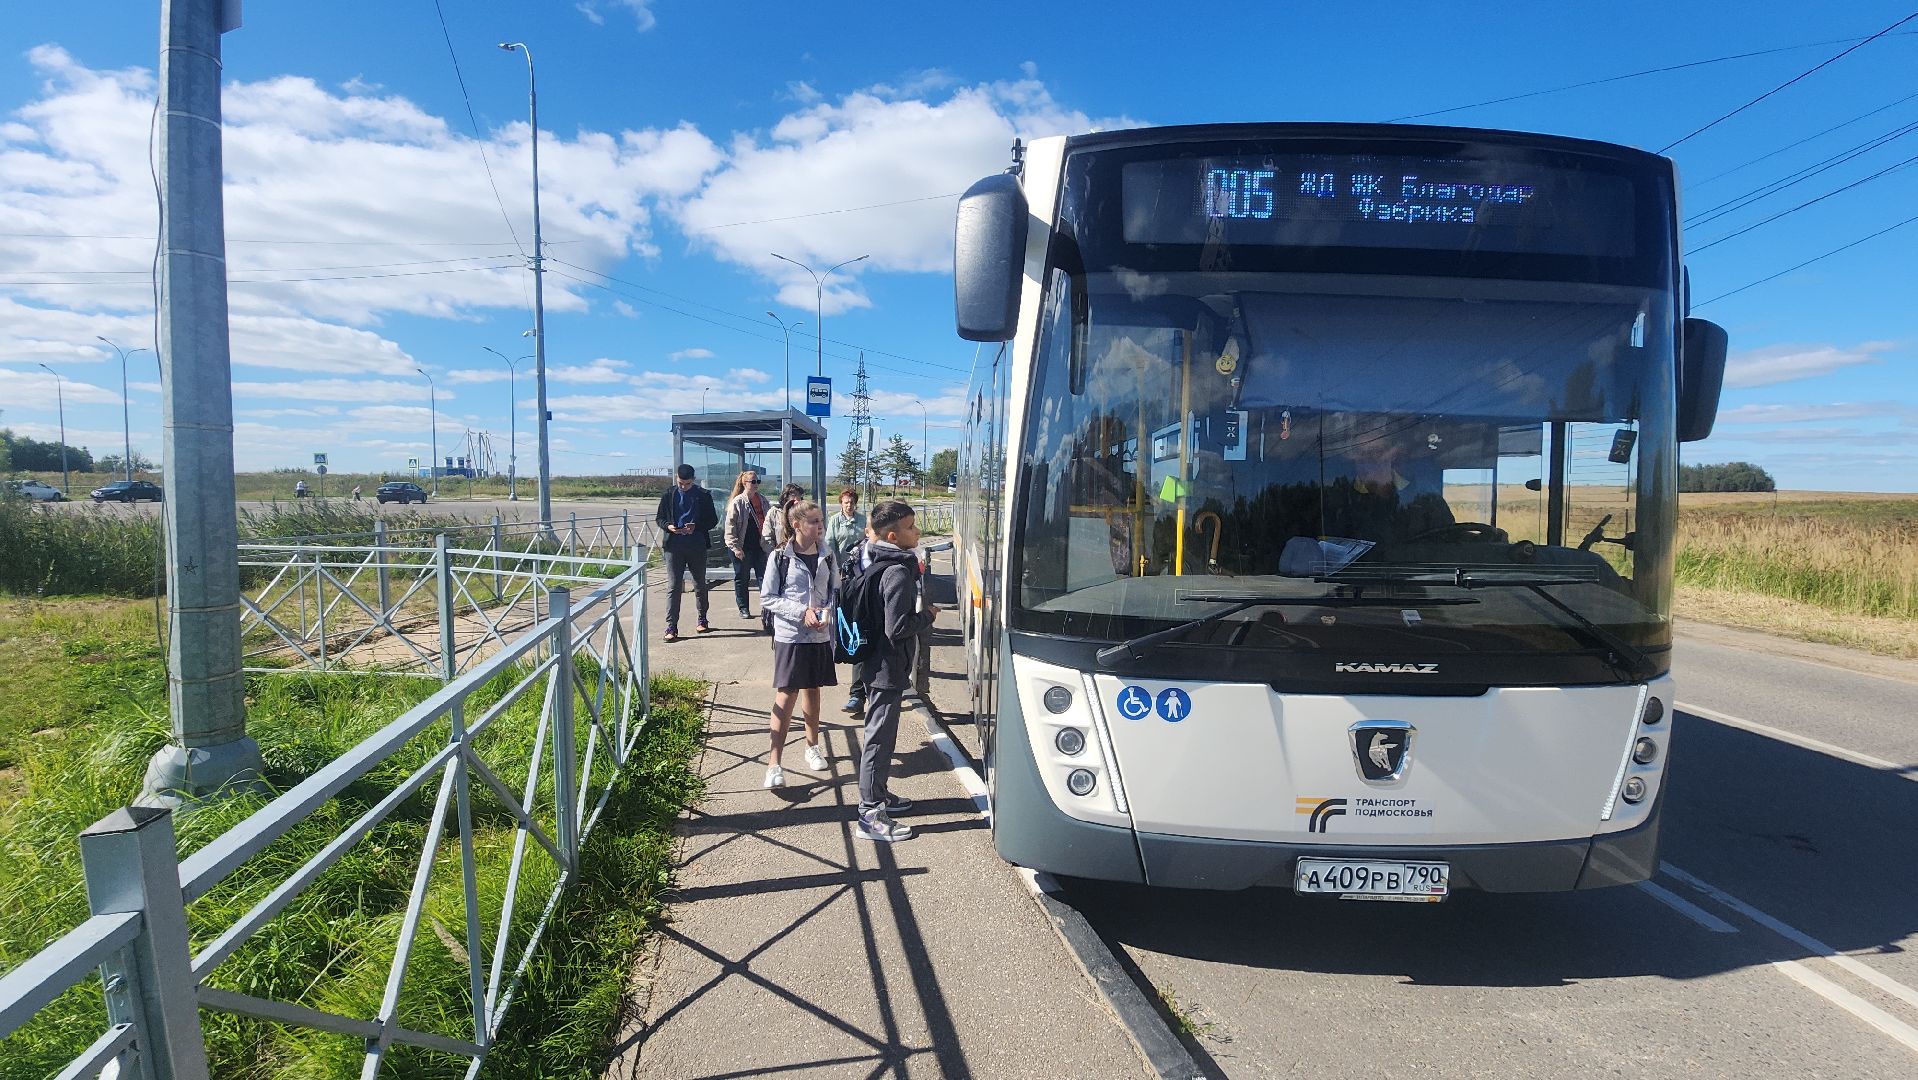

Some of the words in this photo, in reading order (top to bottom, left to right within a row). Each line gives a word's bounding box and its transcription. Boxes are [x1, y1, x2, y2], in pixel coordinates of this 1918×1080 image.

[1300, 173, 1336, 198] ЖД
[1335, 662, 1439, 674] KAMAZ
[1355, 798, 1417, 808] ТРАНСПОРТ
[1355, 808, 1433, 818] ПОДМОСКОВЬЯ
[1406, 866, 1442, 885] 790
[1413, 884, 1431, 892] RUS
